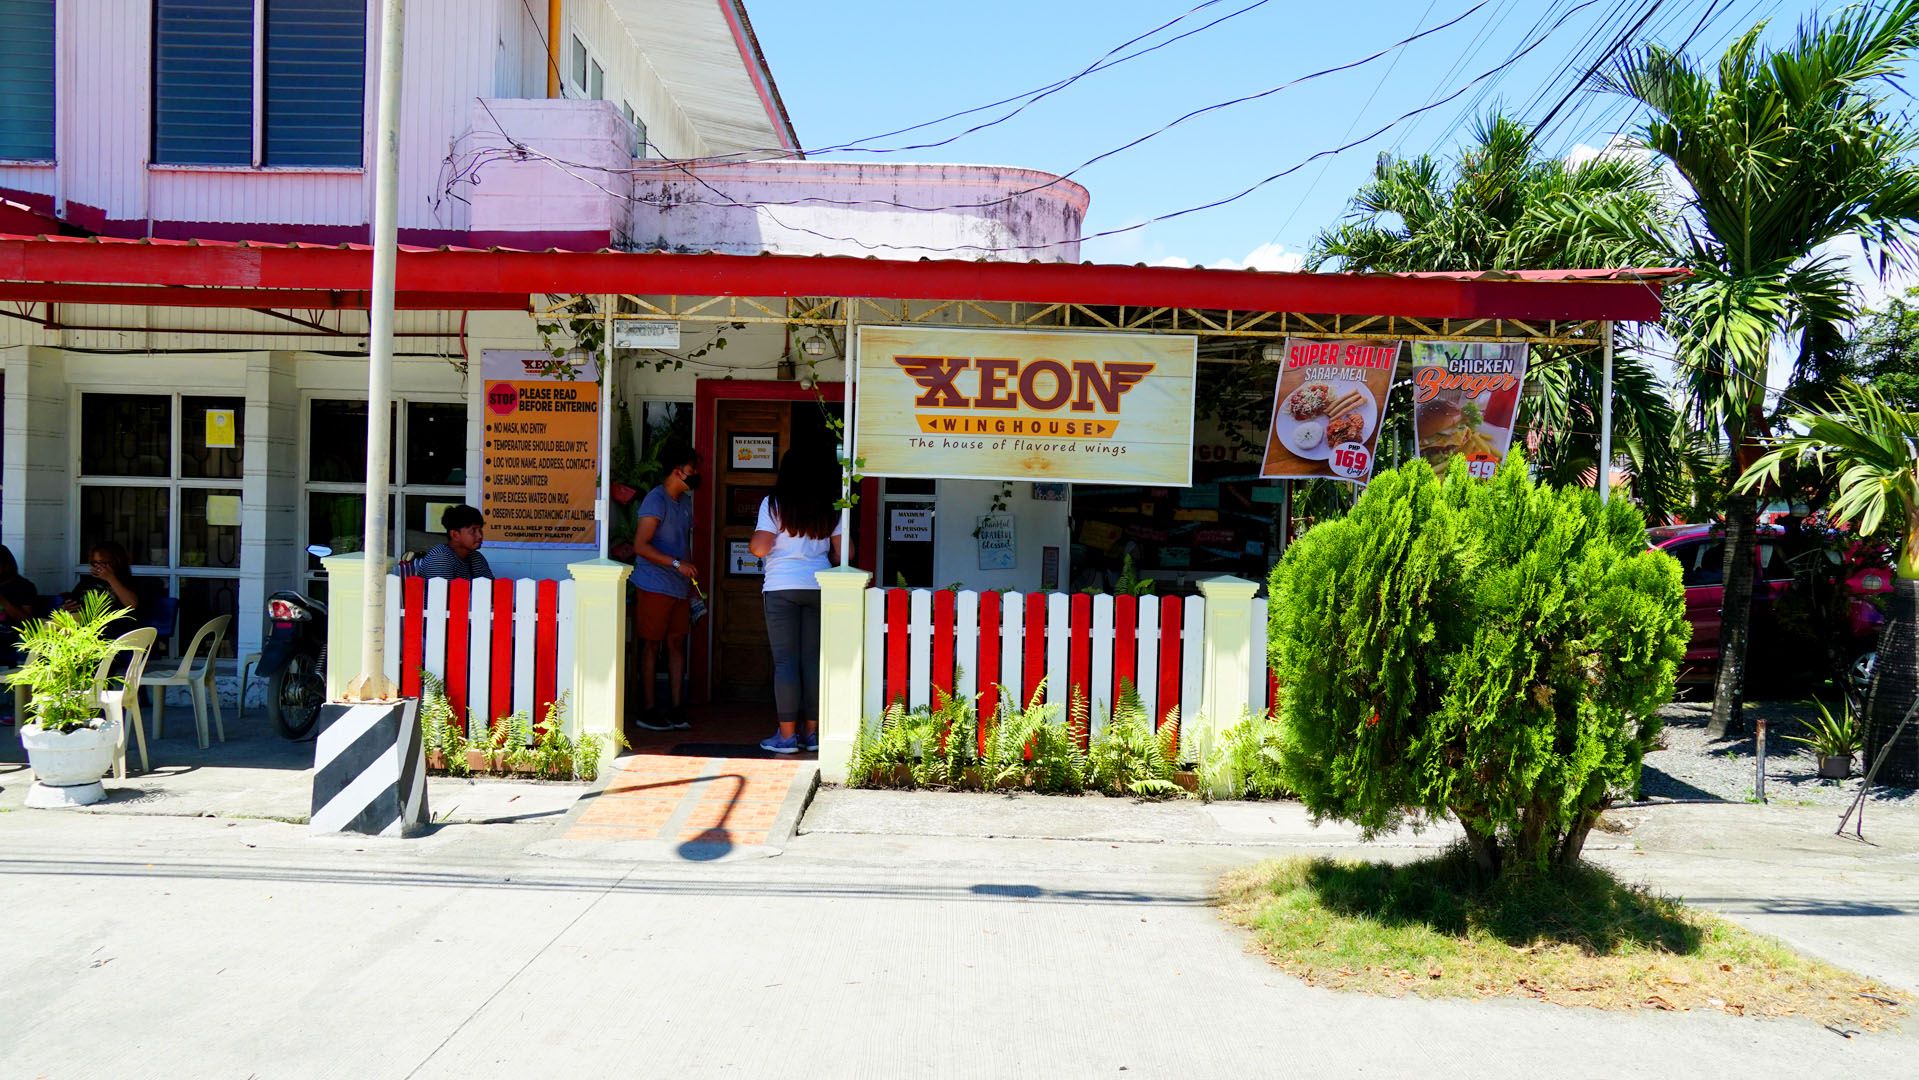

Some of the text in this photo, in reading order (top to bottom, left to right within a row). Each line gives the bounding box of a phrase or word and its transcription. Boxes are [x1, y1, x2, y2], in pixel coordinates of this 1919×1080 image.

[1289, 343, 1395, 370] SUPER SULIT
[1448, 359, 1513, 374] CHICKEN
[893, 355, 1155, 414] XEON
[1416, 366, 1519, 403] Burger
[489, 393, 515, 405] STOP
[519, 388, 577, 400] PLEASE READ
[519, 401, 597, 412] BEFORE ENTERING
[493, 422, 547, 434] NO MASK, NO ENTRY
[944, 418, 1093, 435] WINGHOUSE
[493, 439, 532, 451] TEMPERATURE
[532, 440, 555, 452] SHOULD
[555, 441, 575, 452] BELOW
[909, 438, 1127, 456] The house of flavored wings
[493, 457, 504, 468] LOG
[505, 457, 519, 468] YOUR
[566, 459, 590, 469] CONTACT
[1335, 449, 1367, 470] 169
[493, 474, 548, 486] USE HAND SANITIZER
[492, 491, 569, 504] WIPE EXCESS WATER ON RUG
[492, 508, 595, 520] OBSERVE SOCIAL DISTANCING AT ALL TIMES
